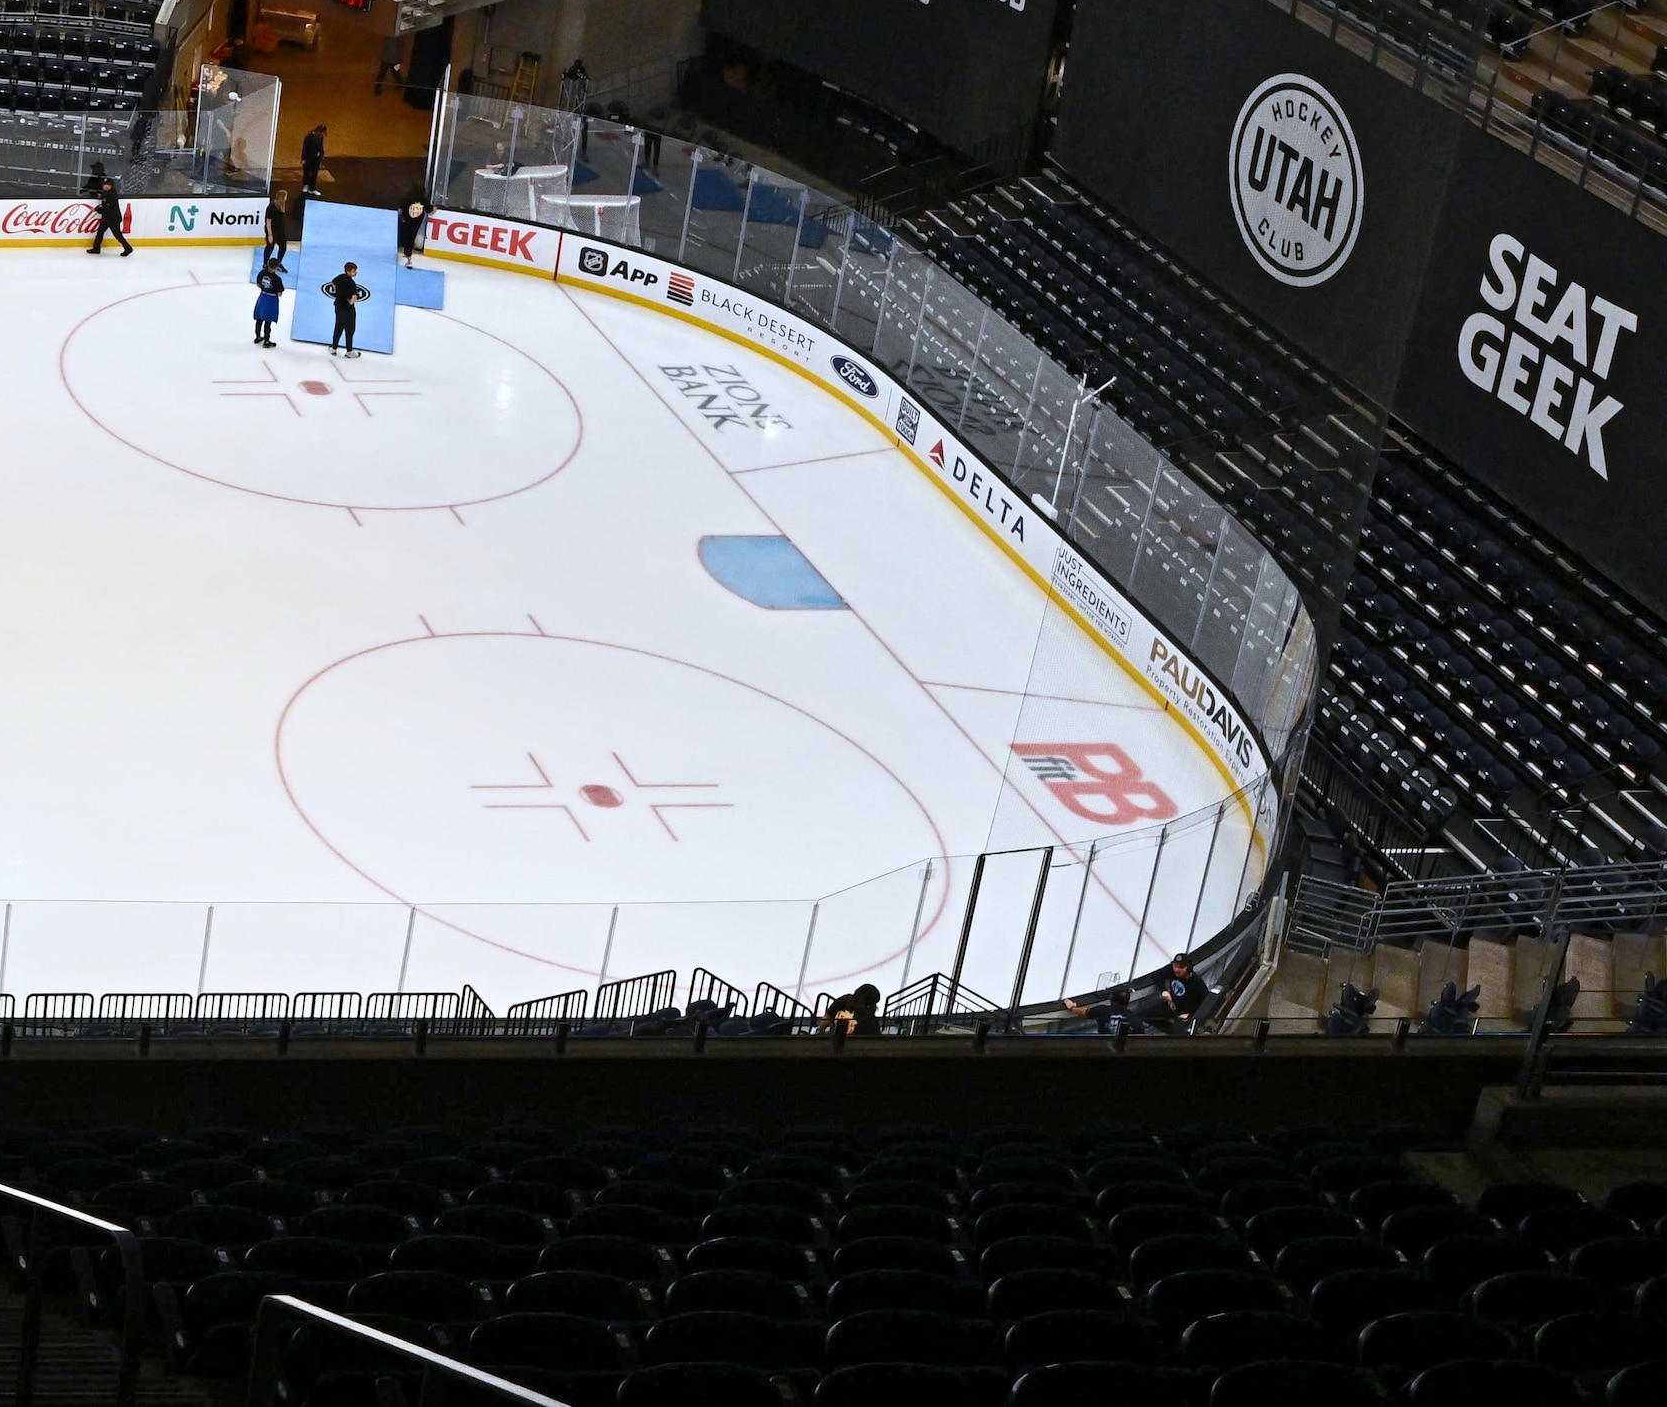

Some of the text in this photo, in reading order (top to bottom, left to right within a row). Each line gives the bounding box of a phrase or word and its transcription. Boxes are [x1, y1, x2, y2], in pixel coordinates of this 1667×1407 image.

[1272, 100, 1342, 158] HOCKEY
[1248, 126, 1343, 242] UTAH
[1, 203, 100, 234] Coca-Cola
[210, 210, 260, 226] Nomi
[1258, 218, 1303, 261] CLUB
[701, 289, 815, 352] BLACK DESERT
[1479, 233, 1638, 380] SEAT
[747, 326, 810, 363] RESORT
[658, 365, 750, 433] BANK
[702, 364, 793, 430] ZIONS
[839, 361, 869, 394] Ford
[1458, 312, 1624, 482] GEEK
[897, 421, 914, 440] TOUGH
[901, 400, 918, 423] BUILT
[953, 456, 1024, 543] DELTA
[1058, 548, 1084, 575] JUST
[1057, 561, 1127, 636] INGREDIENTS
[1146, 665, 1181, 705] Property
[1183, 701, 1224, 749] Restoration
